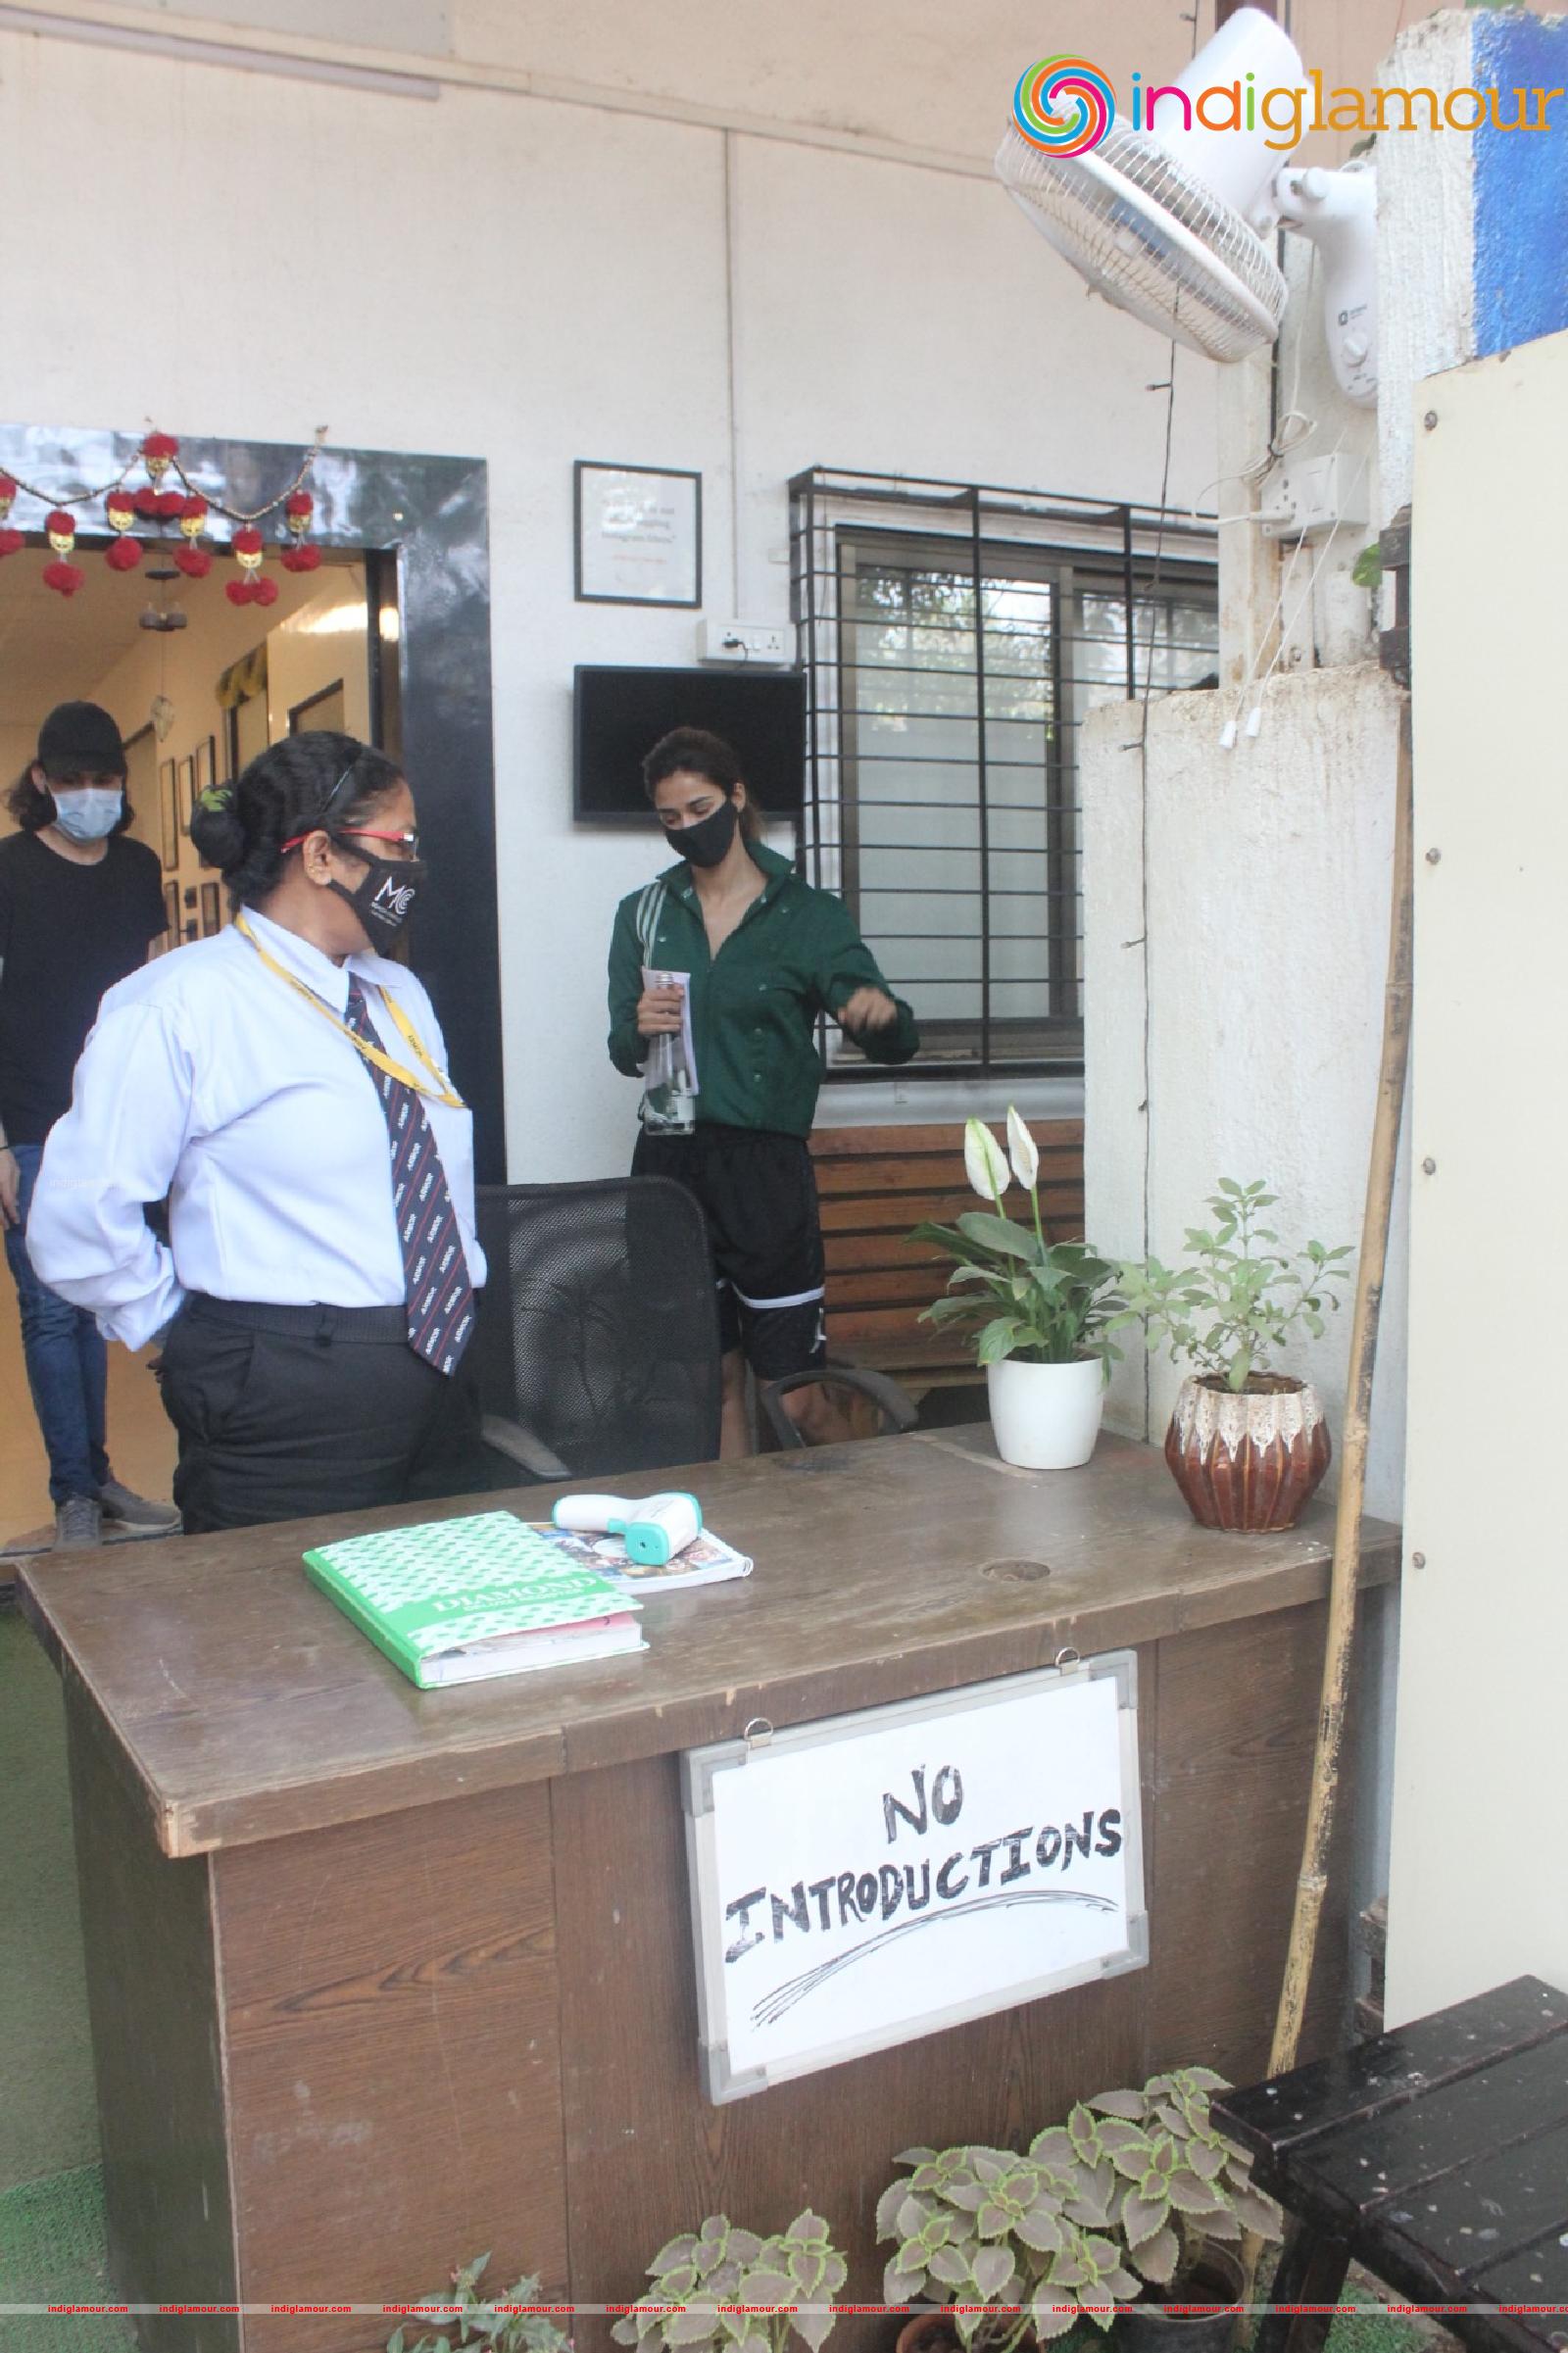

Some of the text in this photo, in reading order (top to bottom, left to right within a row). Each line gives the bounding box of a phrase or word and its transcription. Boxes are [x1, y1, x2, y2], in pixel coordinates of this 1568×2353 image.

[432, 1578, 596, 1611] DIAMOND
[882, 1765, 963, 1844] NO
[725, 1808, 1122, 1963] INTRODUCTIONS
